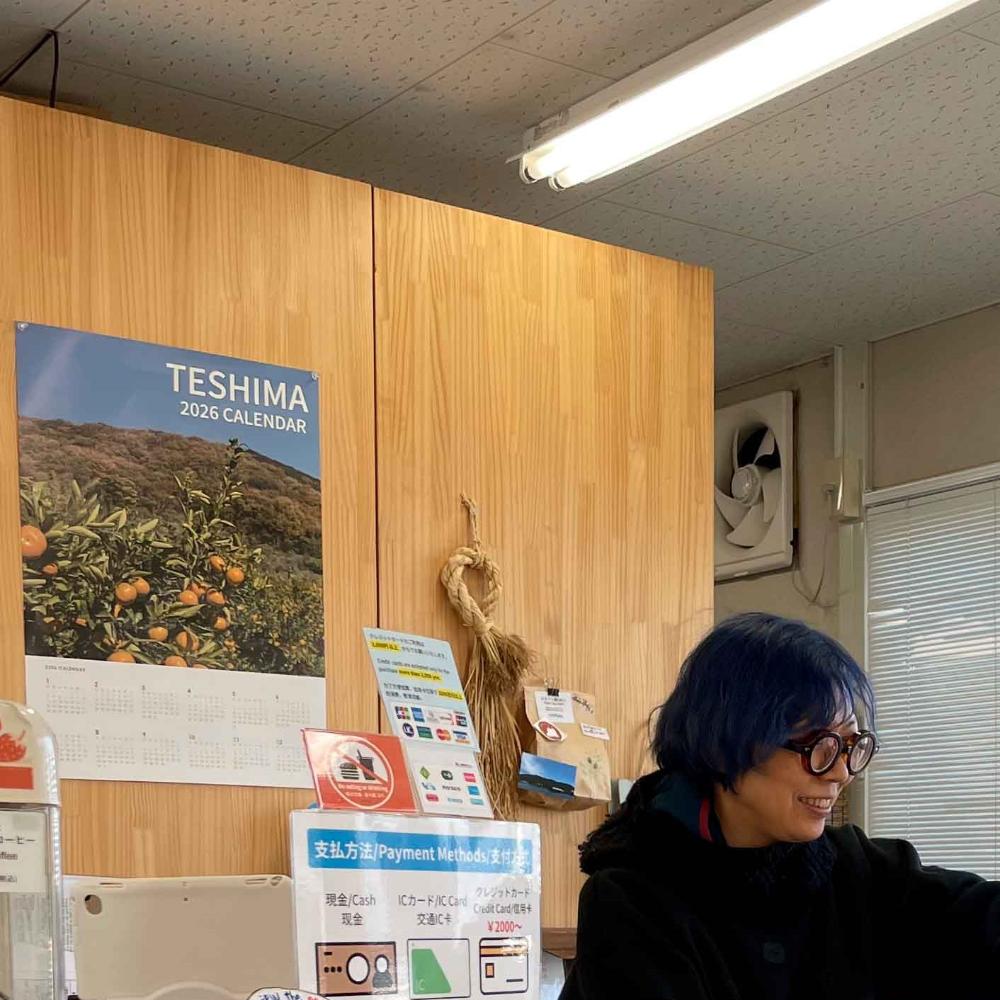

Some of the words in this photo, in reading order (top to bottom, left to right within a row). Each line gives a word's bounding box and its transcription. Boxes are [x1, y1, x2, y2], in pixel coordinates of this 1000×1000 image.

[166, 362, 309, 413] TESHIMA
[180, 401, 219, 420] 2026
[223, 407, 307, 434] CALENDAR
[314, 840, 435, 863] 支払方法/Payment
[325, 892, 376, 908] 現金/Cash
[473, 903, 495, 914] Credit
[341, 912, 364, 926] 现金
[417, 912, 452, 926] 交通IC卡
